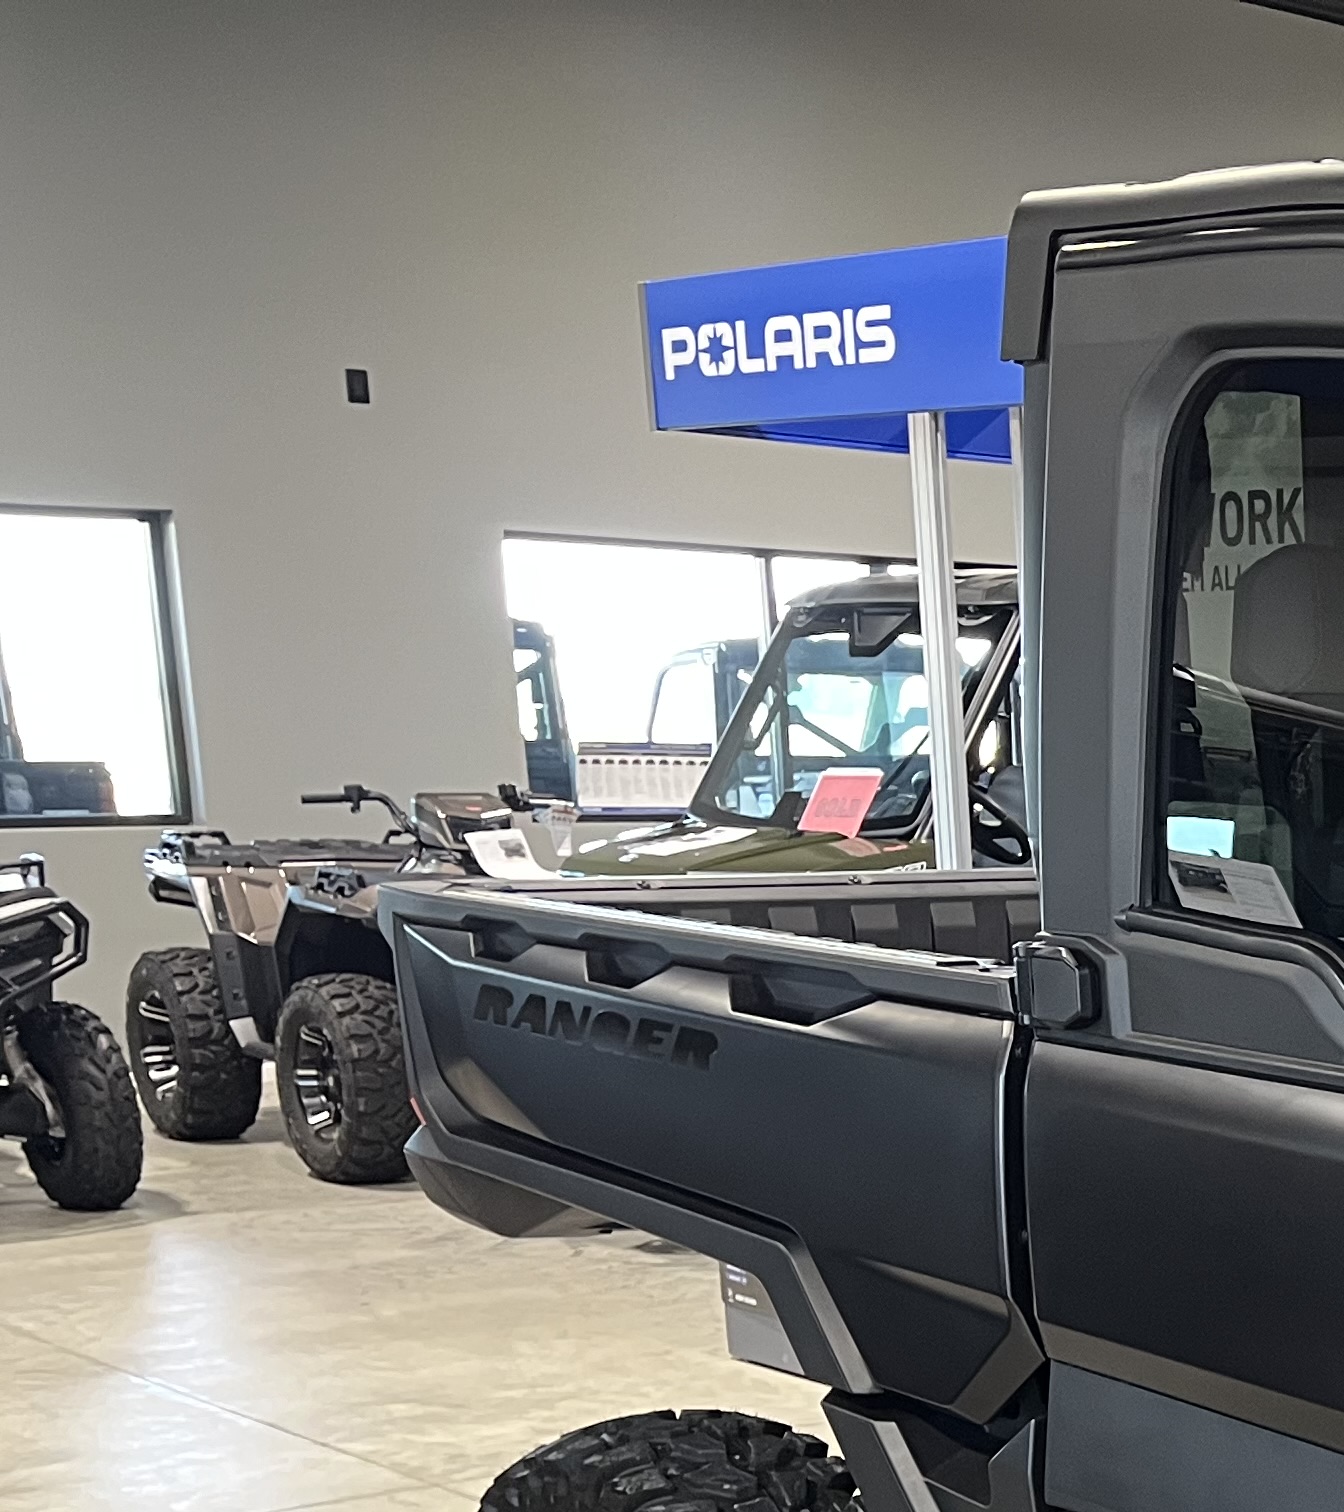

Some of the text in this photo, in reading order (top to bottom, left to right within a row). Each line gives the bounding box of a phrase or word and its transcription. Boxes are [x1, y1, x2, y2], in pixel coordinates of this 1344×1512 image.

[661, 304, 896, 381] POLARIS
[1208, 487, 1303, 547] ORK
[473, 983, 719, 1071] RANGER
